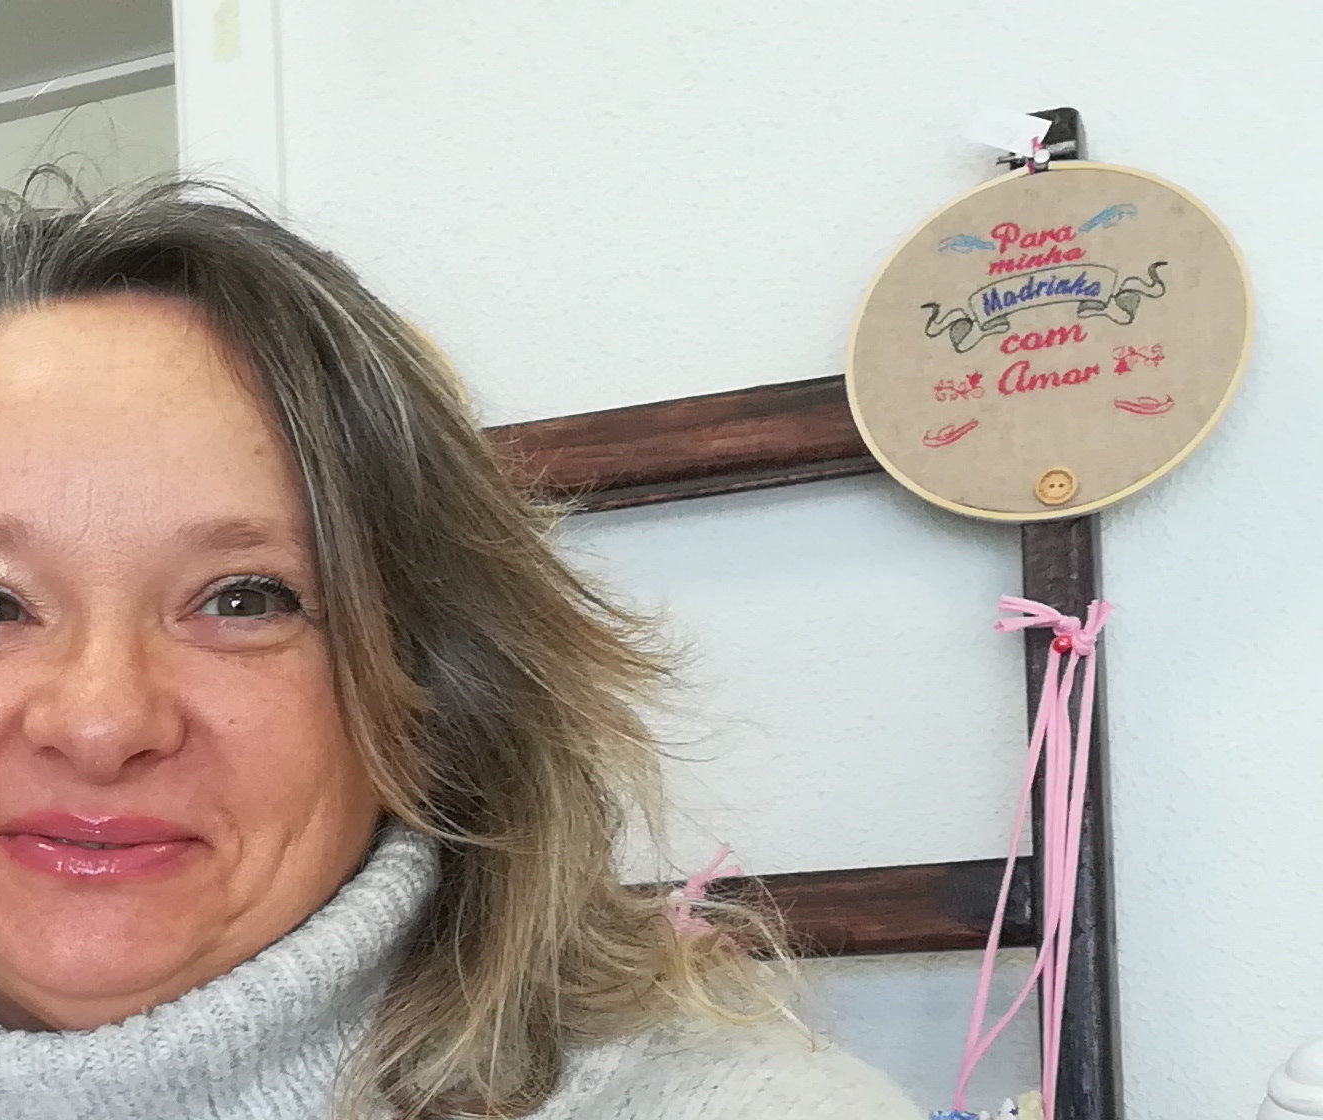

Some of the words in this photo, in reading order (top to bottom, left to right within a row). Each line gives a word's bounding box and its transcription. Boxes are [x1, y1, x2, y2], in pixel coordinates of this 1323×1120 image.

[990, 222, 1077, 254] Para
[987, 245, 1086, 275] minha
[982, 271, 1101, 316] Madrinha
[1000, 324, 1088, 354] com
[998, 360, 1100, 396] Amor
